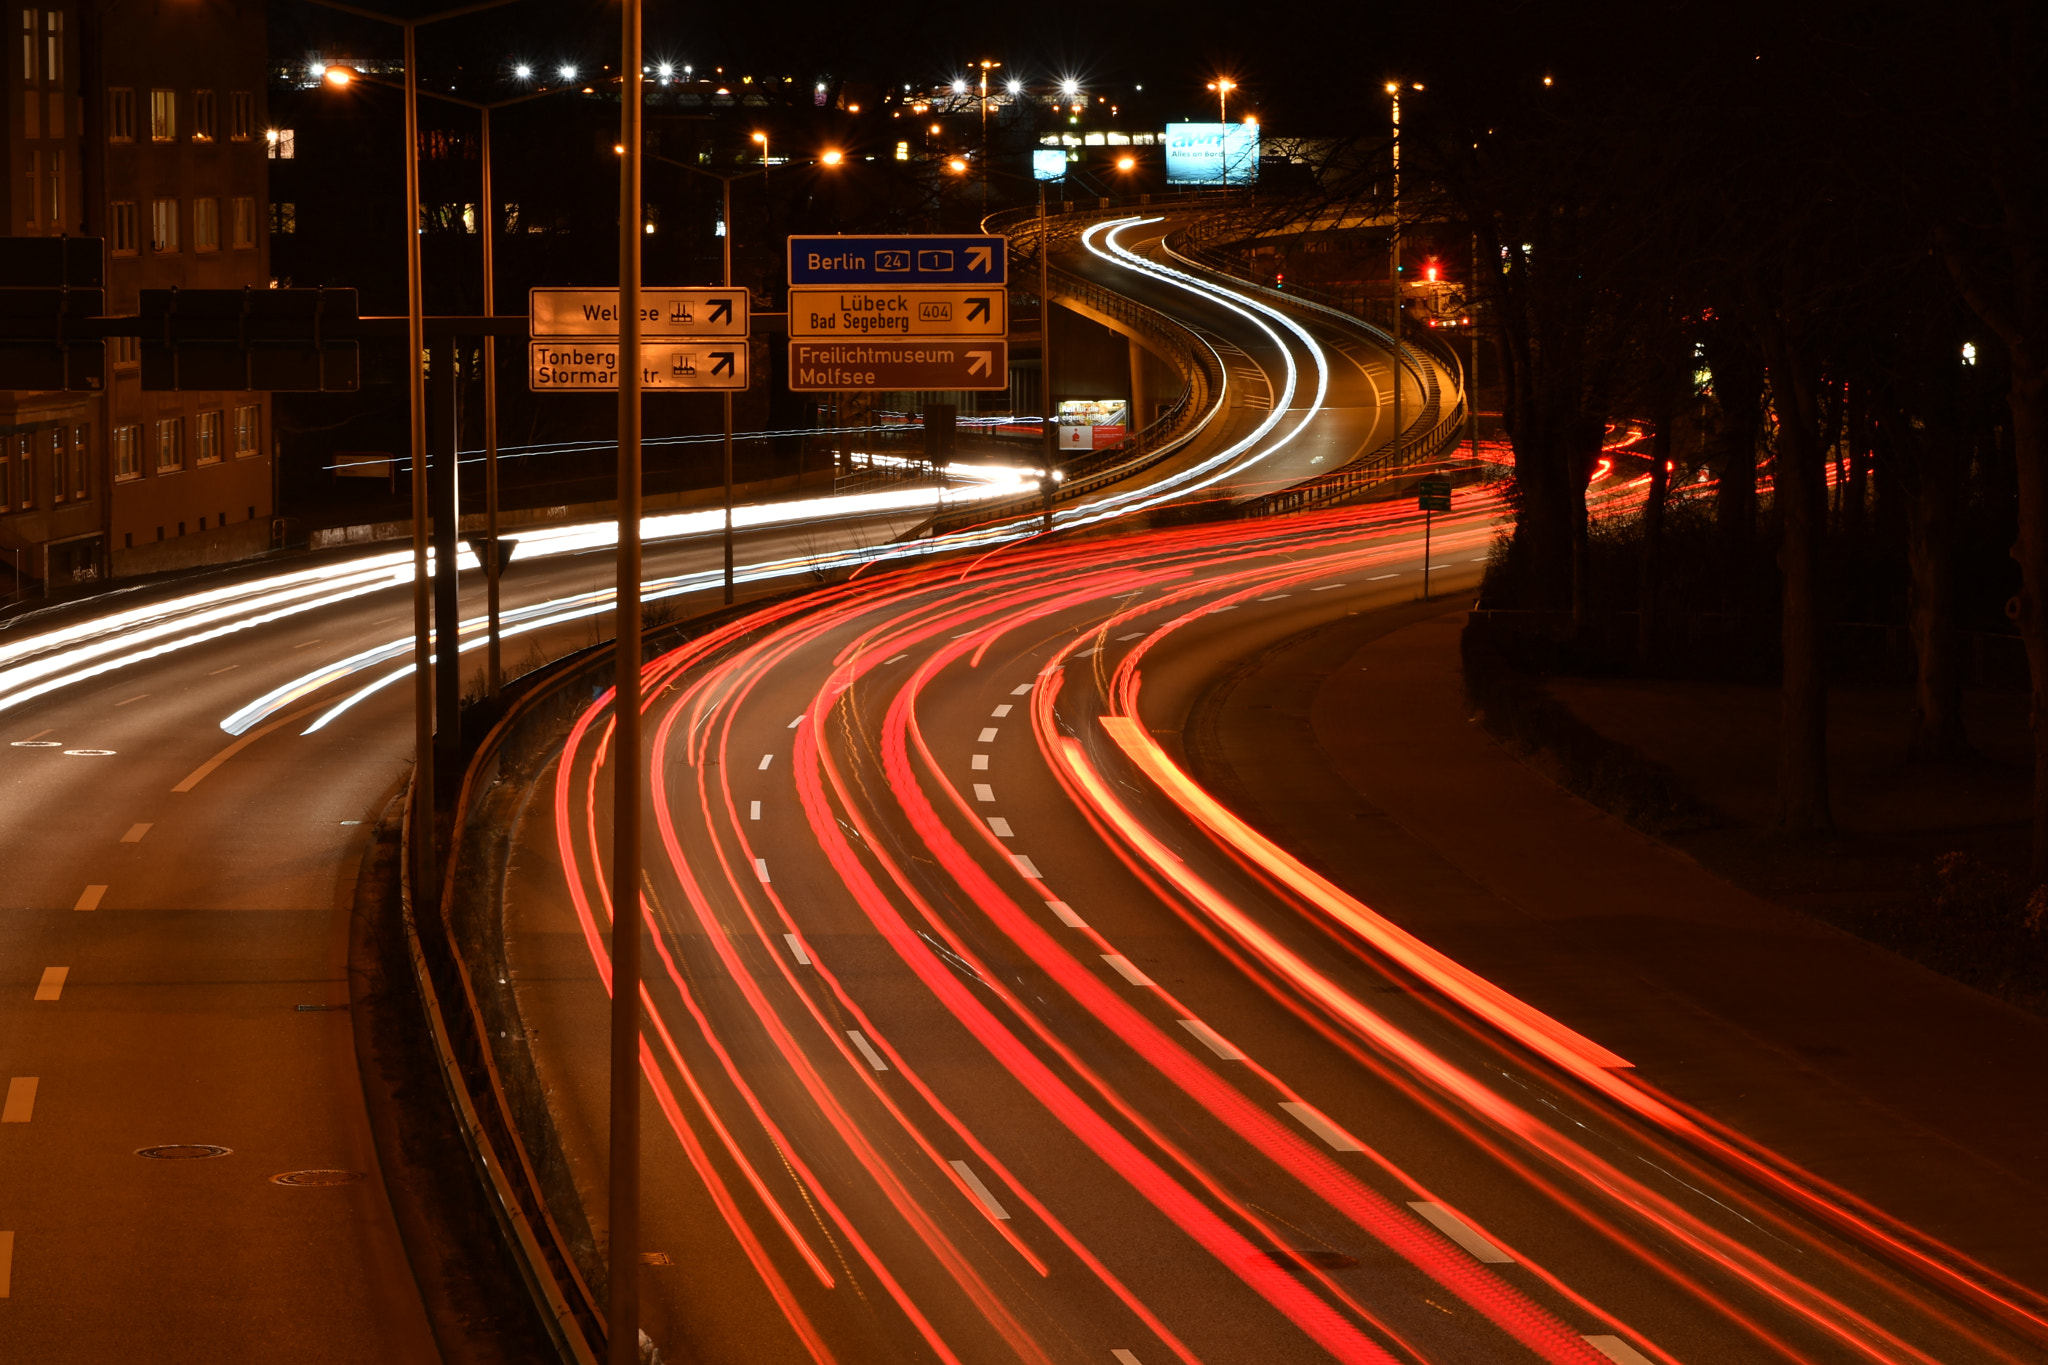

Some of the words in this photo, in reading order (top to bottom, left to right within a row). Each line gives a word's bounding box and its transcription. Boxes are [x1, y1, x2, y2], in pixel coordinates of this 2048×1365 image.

[808, 253, 865, 270] Berlin
[884, 255, 901, 268] 24
[933, 254, 939, 268] 1
[840, 295, 908, 311] Lübeck
[583, 305, 659, 321] Welee
[922, 305, 949, 318] 404
[810, 313, 835, 329] Bad
[843, 313, 909, 333] Segeberg
[538, 349, 615, 369] Tonberg
[800, 347, 955, 364] Freilichtmuseum
[538, 367, 662, 383] Stormartr.
[800, 368, 875, 385] Molfsee
[1062, 414, 1085, 422] eigene
